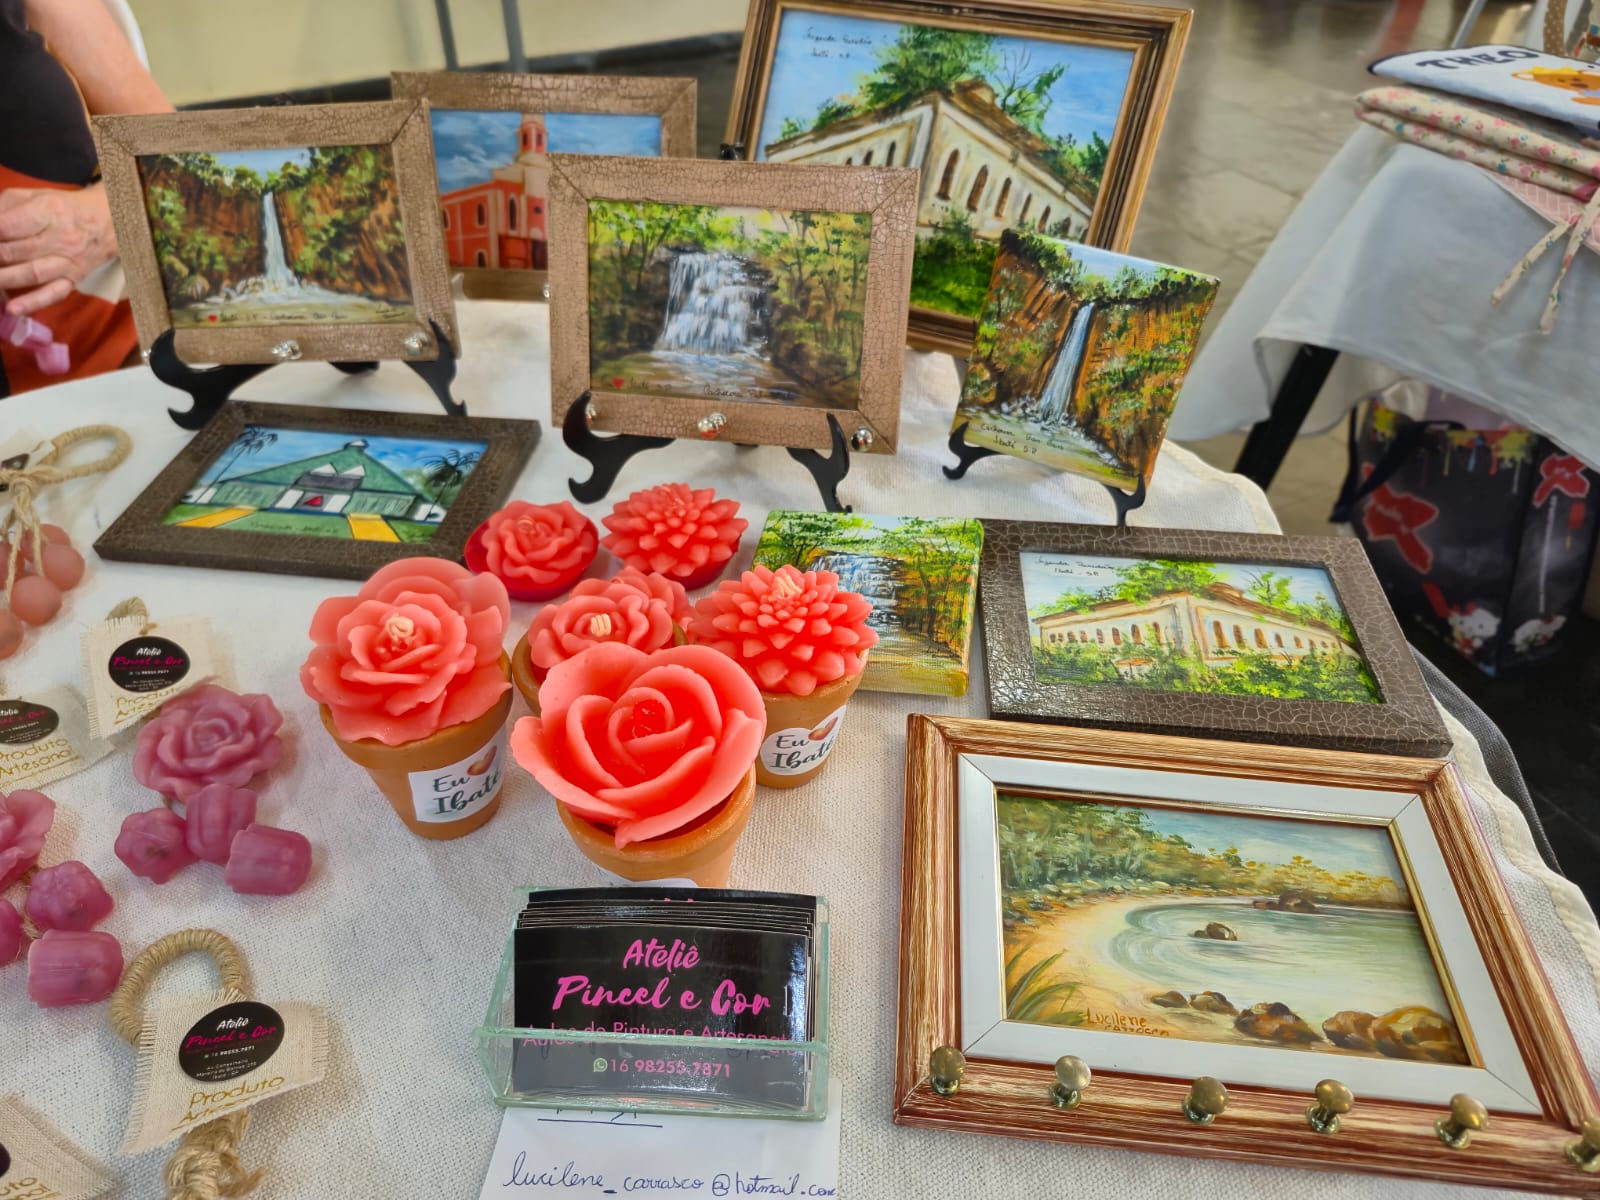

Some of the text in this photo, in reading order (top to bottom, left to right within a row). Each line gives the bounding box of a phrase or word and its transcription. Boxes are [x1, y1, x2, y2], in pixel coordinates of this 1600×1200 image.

[775, 734, 810, 750] Eu
[432, 774, 471, 793] Eu
[622, 937, 700, 973] Ateliê
[551, 975, 772, 1017] Pincel e Cor
[610, 1058, 630, 1073] 16
